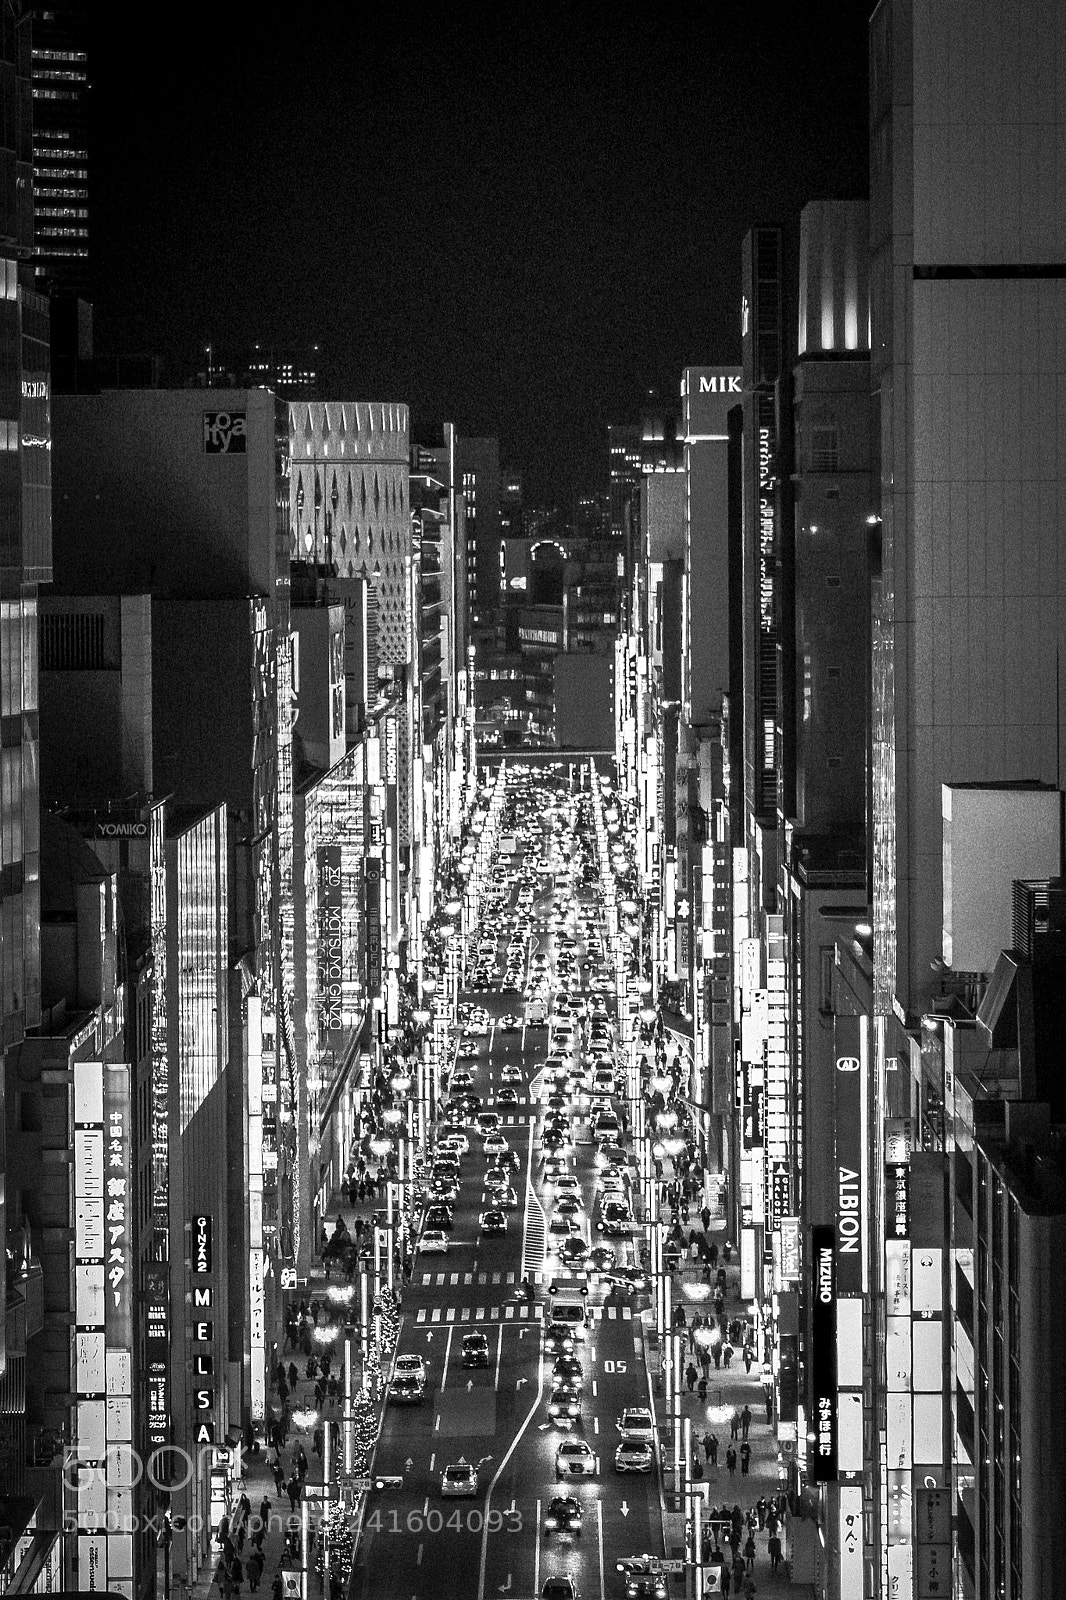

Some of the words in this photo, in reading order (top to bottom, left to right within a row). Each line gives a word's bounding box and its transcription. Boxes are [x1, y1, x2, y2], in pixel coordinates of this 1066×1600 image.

[699, 376, 742, 393] MIK
[386, 717, 397, 785] MITSUKOSHI
[98, 823, 147, 836] YOMIKO
[109, 1111, 123, 1167] 中国名菜
[838, 1166, 860, 1253] ALBION
[107, 1177, 127, 1308] 銀座アスター
[819, 1247, 832, 1303] MIZUHO
[194, 1287, 211, 1443] MELSA
[818, 1397, 832, 1456] みずほ銀行
